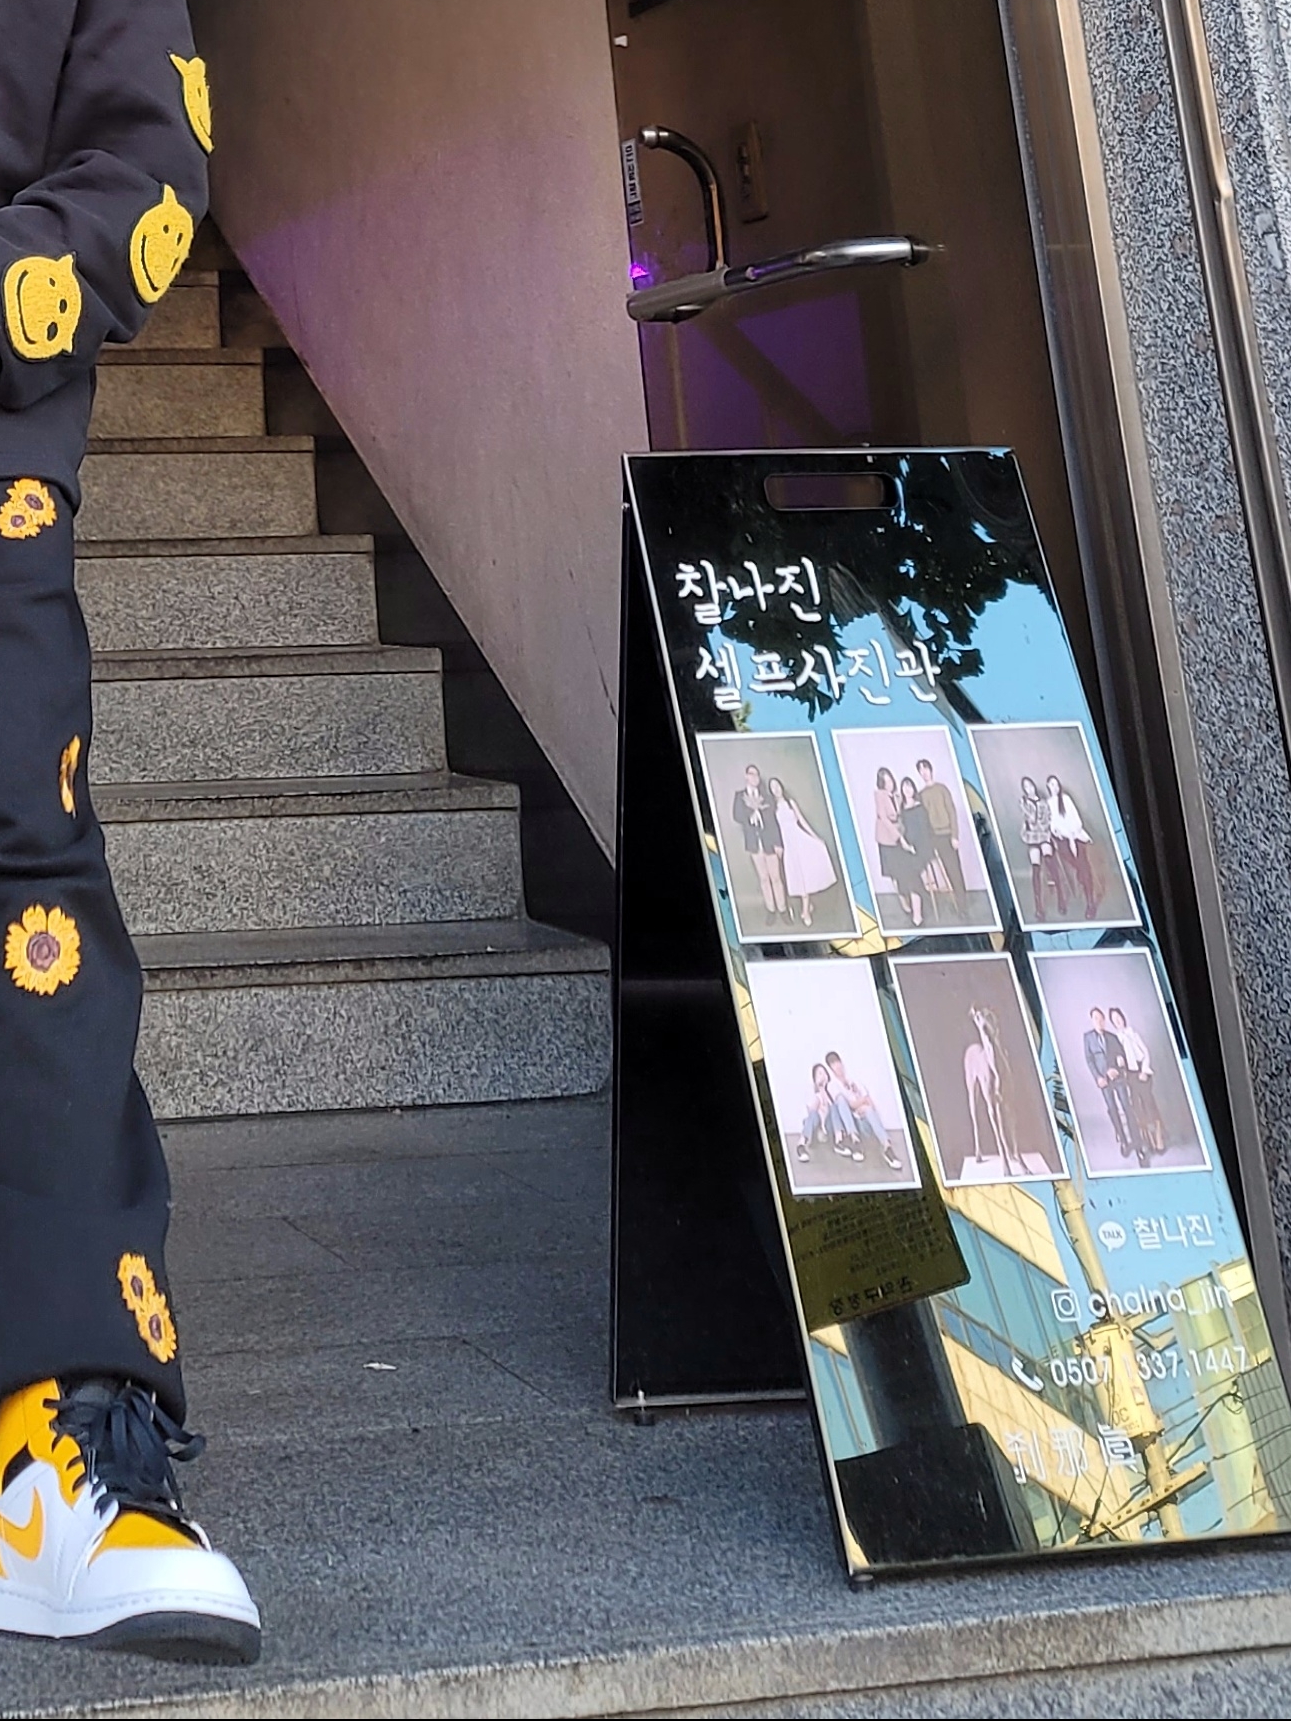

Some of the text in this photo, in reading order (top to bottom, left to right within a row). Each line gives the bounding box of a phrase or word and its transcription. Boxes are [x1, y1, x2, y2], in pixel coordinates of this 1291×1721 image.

[674, 556, 823, 625] 찰나진
[694, 638, 942, 711] 셀프사진관
[1132, 1213, 1216, 1251] 찰나진
[1087, 1280, 1234, 1320] chalna_jin
